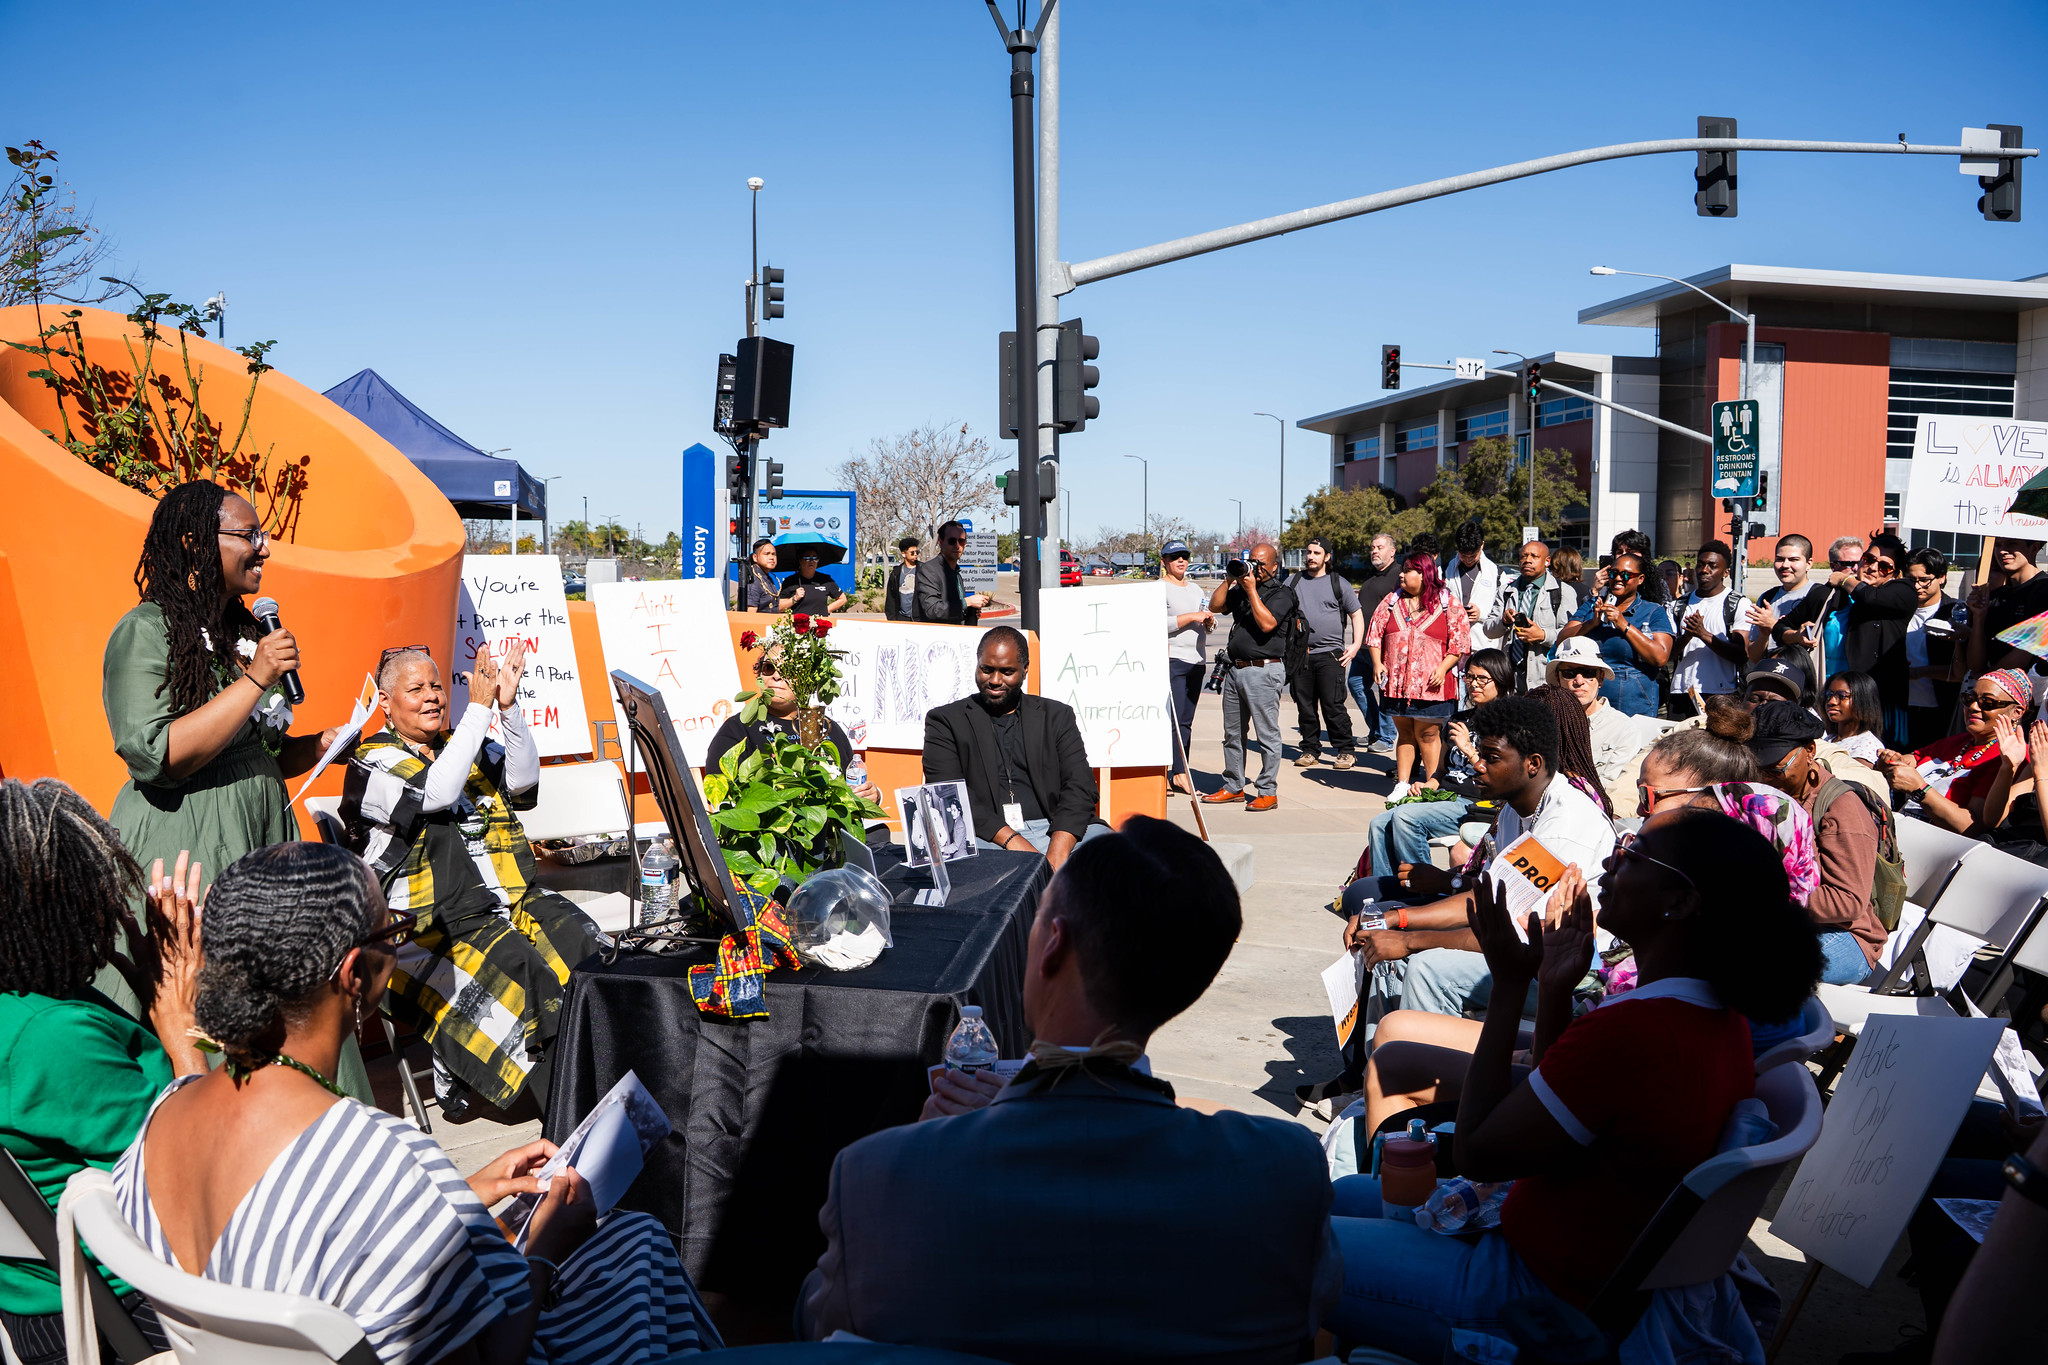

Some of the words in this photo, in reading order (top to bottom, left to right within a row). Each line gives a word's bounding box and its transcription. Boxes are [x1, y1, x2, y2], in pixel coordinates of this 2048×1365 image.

[1716, 453, 1756, 462] RESTROOMS
[1718, 462, 1753, 470] DRINKING
[1719, 470, 1752, 478] FOUNTAIN
[1940, 462, 1961, 484] is
[1965, 464, 2048, 489] ALWAY
[758, 502, 785, 511] elcome
[796, 501, 823, 511] Mesa
[1953, 500, 1989, 526] the
[473, 575, 540, 609] You're
[630, 591, 679, 619] Ain't
[473, 613, 509, 630] Part
[514, 612, 531, 626] of
[538, 608, 566, 626] the
[1083, 602, 1111, 635] I
[464, 632, 539, 660] SLUTN
[647, 623, 678, 656] I
[535, 665, 545, 680] A
[548, 666, 575, 682] Part
[654, 657, 682, 689] A
[1056, 652, 1099, 684] Am
[1109, 649, 1146, 676] An
[1067, 689, 1161, 732] American
[1106, 728, 1121, 766] ?
[1850, 1024, 1900, 1088] Hate
[1852, 1081, 1897, 1136] Only
[1841, 1135, 1895, 1187] Hurts
[1790, 1178, 1816, 1222] The
[1809, 1191, 1867, 1240] Hater
